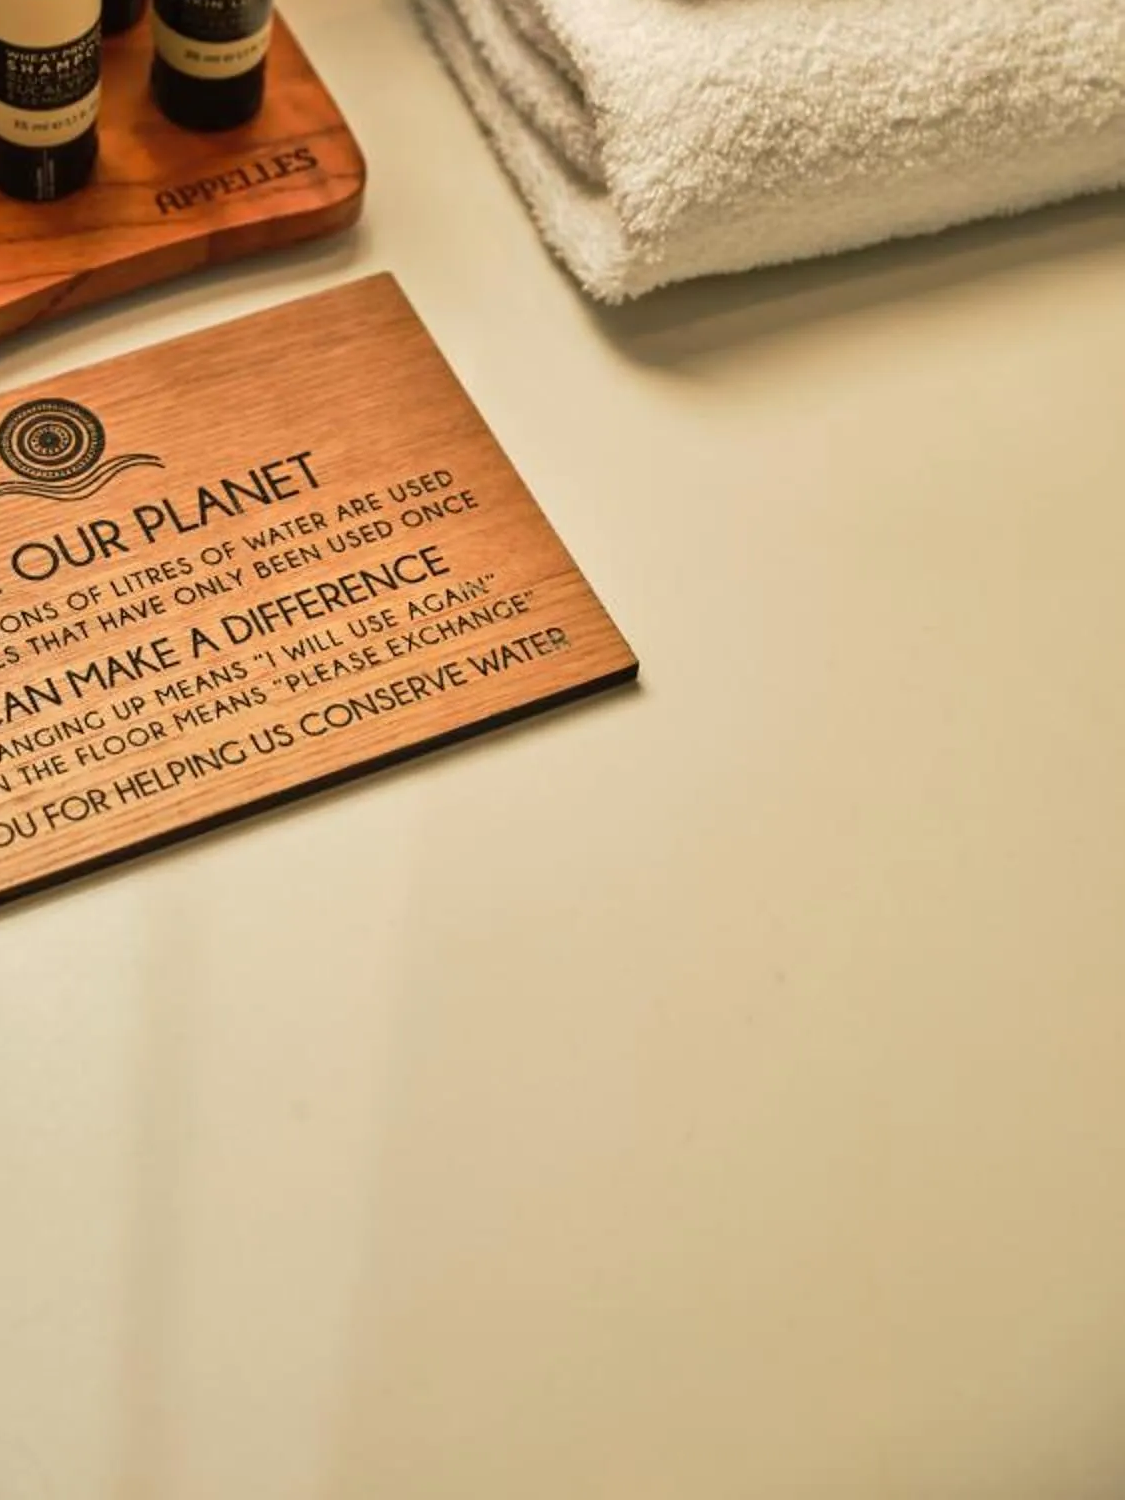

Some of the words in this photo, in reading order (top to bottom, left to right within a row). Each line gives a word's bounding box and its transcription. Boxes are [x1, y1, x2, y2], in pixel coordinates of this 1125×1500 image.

[6, 48, 58, 64] WHEAT
[154, 146, 318, 216] APPELLES
[11, 519, 130, 581] OUR
[133, 451, 320, 544] PLANET
[25, 621, 90, 655] THAT
[97, 595, 167, 633] HAVE
[174, 567, 243, 605] ONLY
[253, 543, 323, 580] BEEN
[326, 520, 394, 554] USED
[400, 489, 480, 529] ONCE
[67, 586, 102, 611] OF
[110, 557, 194, 598] LITRES
[200, 541, 236, 566] OF
[242, 511, 328, 551] WATER
[336, 493, 383, 522] ARE
[388, 469, 454, 503] USED
[65, 636, 181, 698] MAKE
[190, 626, 220, 659] A
[220, 545, 451, 646] DIFFERENCE
[111, 696, 146, 721] UP
[154, 661, 249, 707] MEANS
[281, 629, 344, 662] WILL
[347, 608, 399, 640] USE
[18, 755, 69, 786] THE
[74, 721, 168, 767] FLOOR
[172, 686, 268, 732] MEANS
[42, 788, 112, 830] FOR
[113, 740, 248, 804] HELPING
[249, 723, 295, 755] US
[299, 661, 469, 738] CONSERVE
[467, 626, 572, 678] WATER
